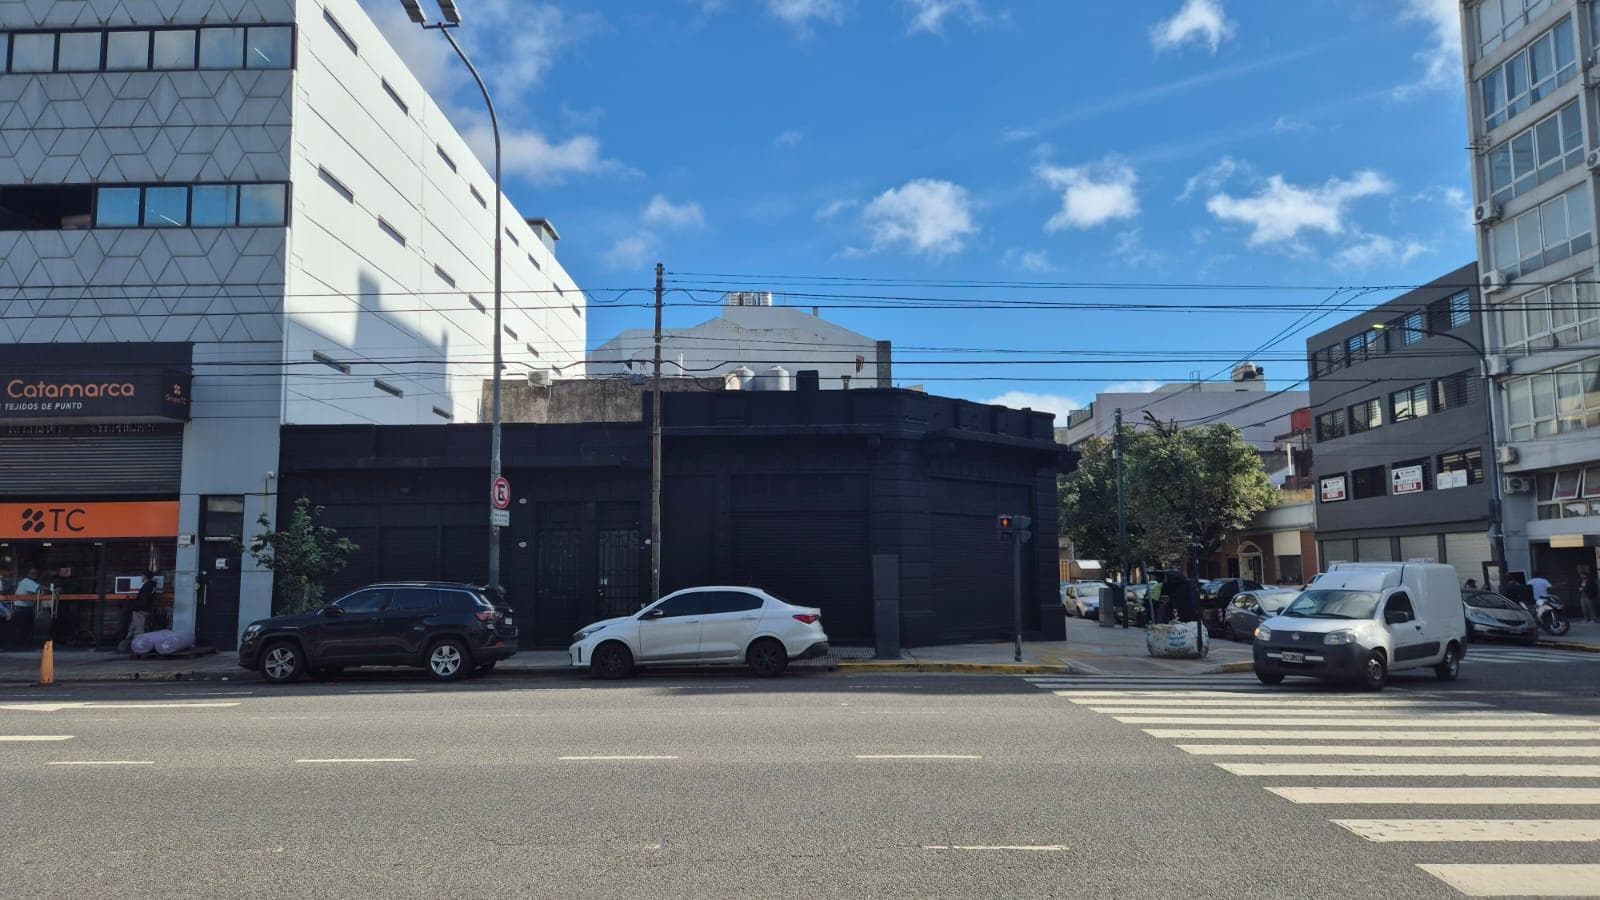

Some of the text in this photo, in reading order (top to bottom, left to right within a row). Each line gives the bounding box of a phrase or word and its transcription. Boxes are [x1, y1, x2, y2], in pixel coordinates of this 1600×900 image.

[7, 379, 135, 398] Catamarca
[5, 402, 39, 411] TEJIDOS
[41, 402, 52, 410] DE
[54, 402, 83, 410] PUNTO
[49, 508, 86, 532] TC
